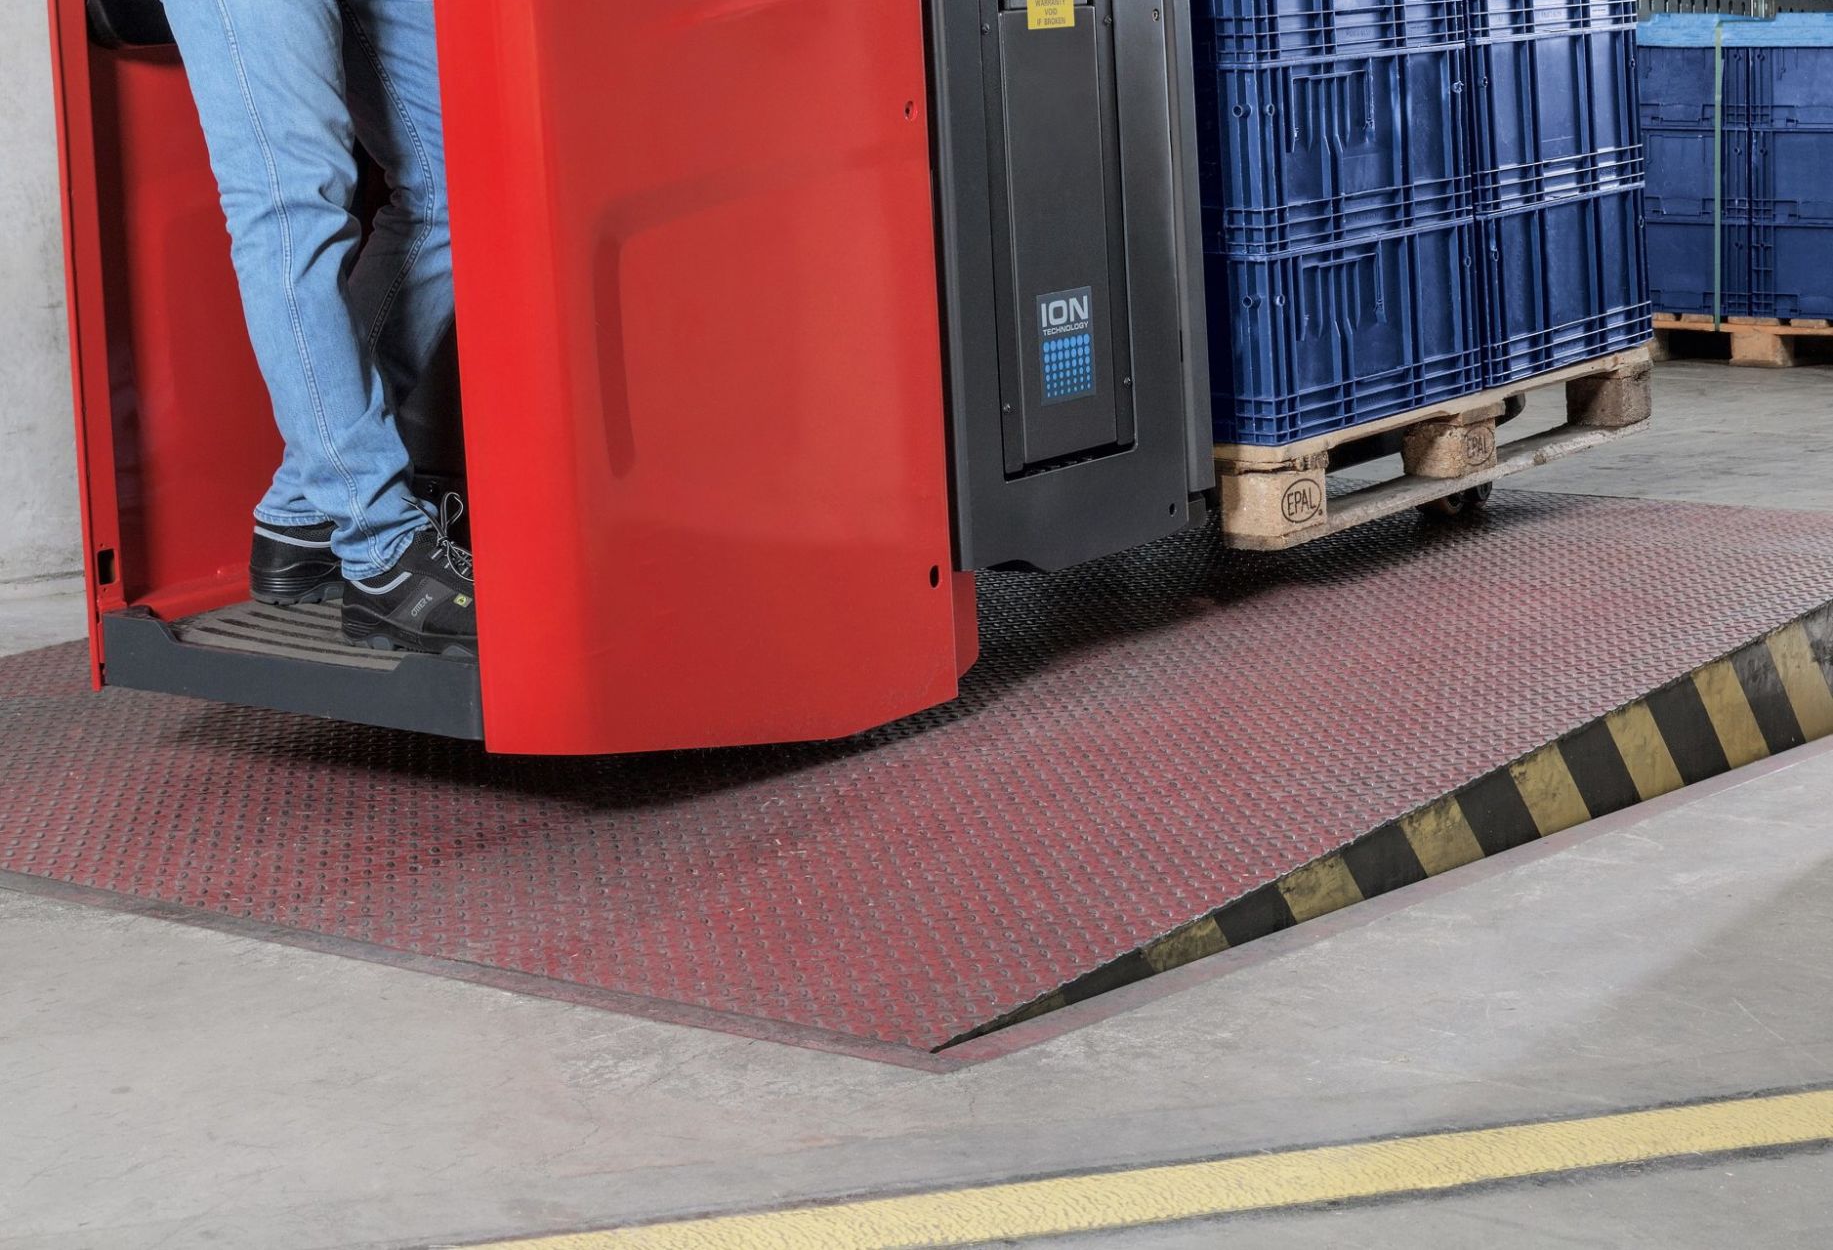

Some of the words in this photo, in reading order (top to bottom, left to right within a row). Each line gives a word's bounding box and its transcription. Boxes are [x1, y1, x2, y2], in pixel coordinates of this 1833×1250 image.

[1041, 295, 1089, 328] ION
[1042, 320, 1089, 337] TECHNOLOGY
[1287, 486, 1317, 517] EPAL
